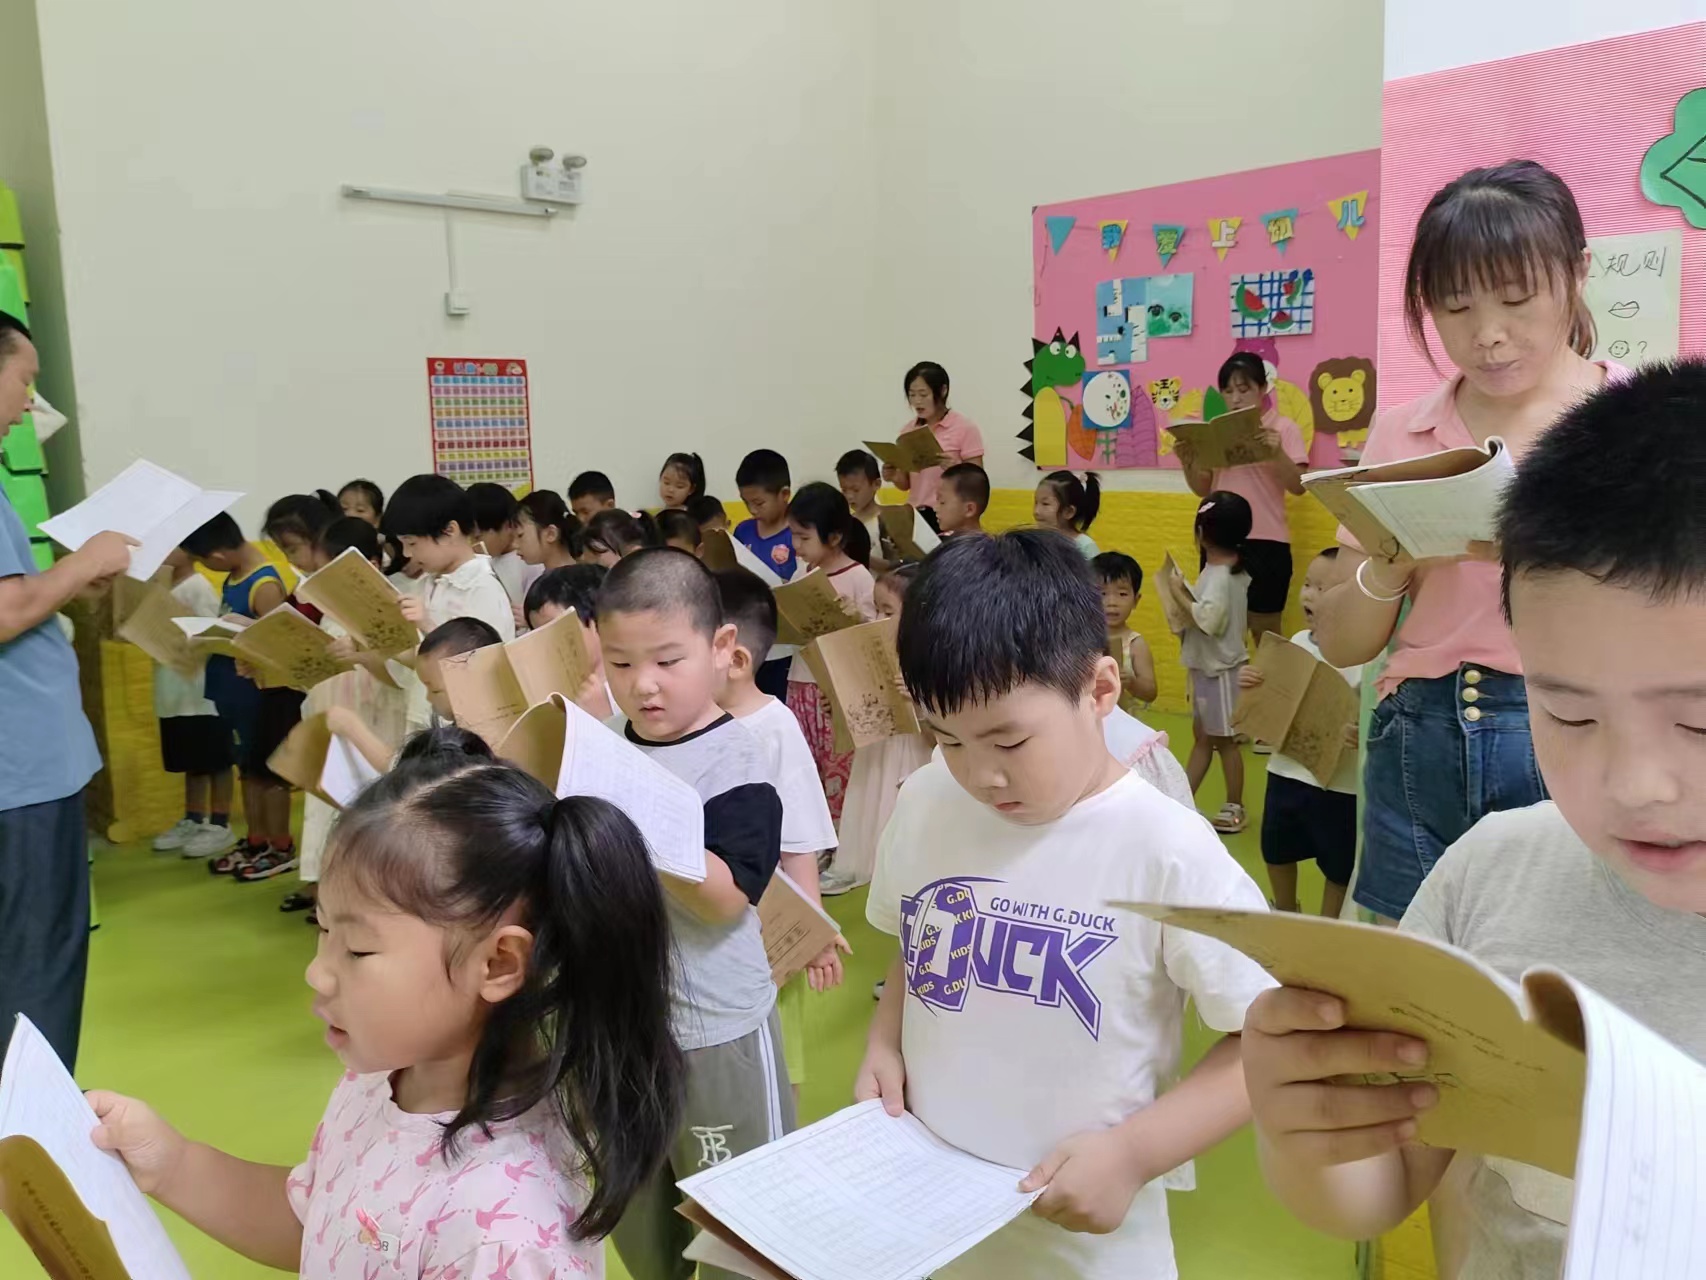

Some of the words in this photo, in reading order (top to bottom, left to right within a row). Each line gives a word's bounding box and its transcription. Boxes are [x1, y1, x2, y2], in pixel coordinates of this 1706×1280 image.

[1590, 247, 1667, 277] 规则
[990, 897, 1010, 912] GO
[1012, 901, 1050, 920] WITH
[1053, 908, 1116, 932] G.DUCK
